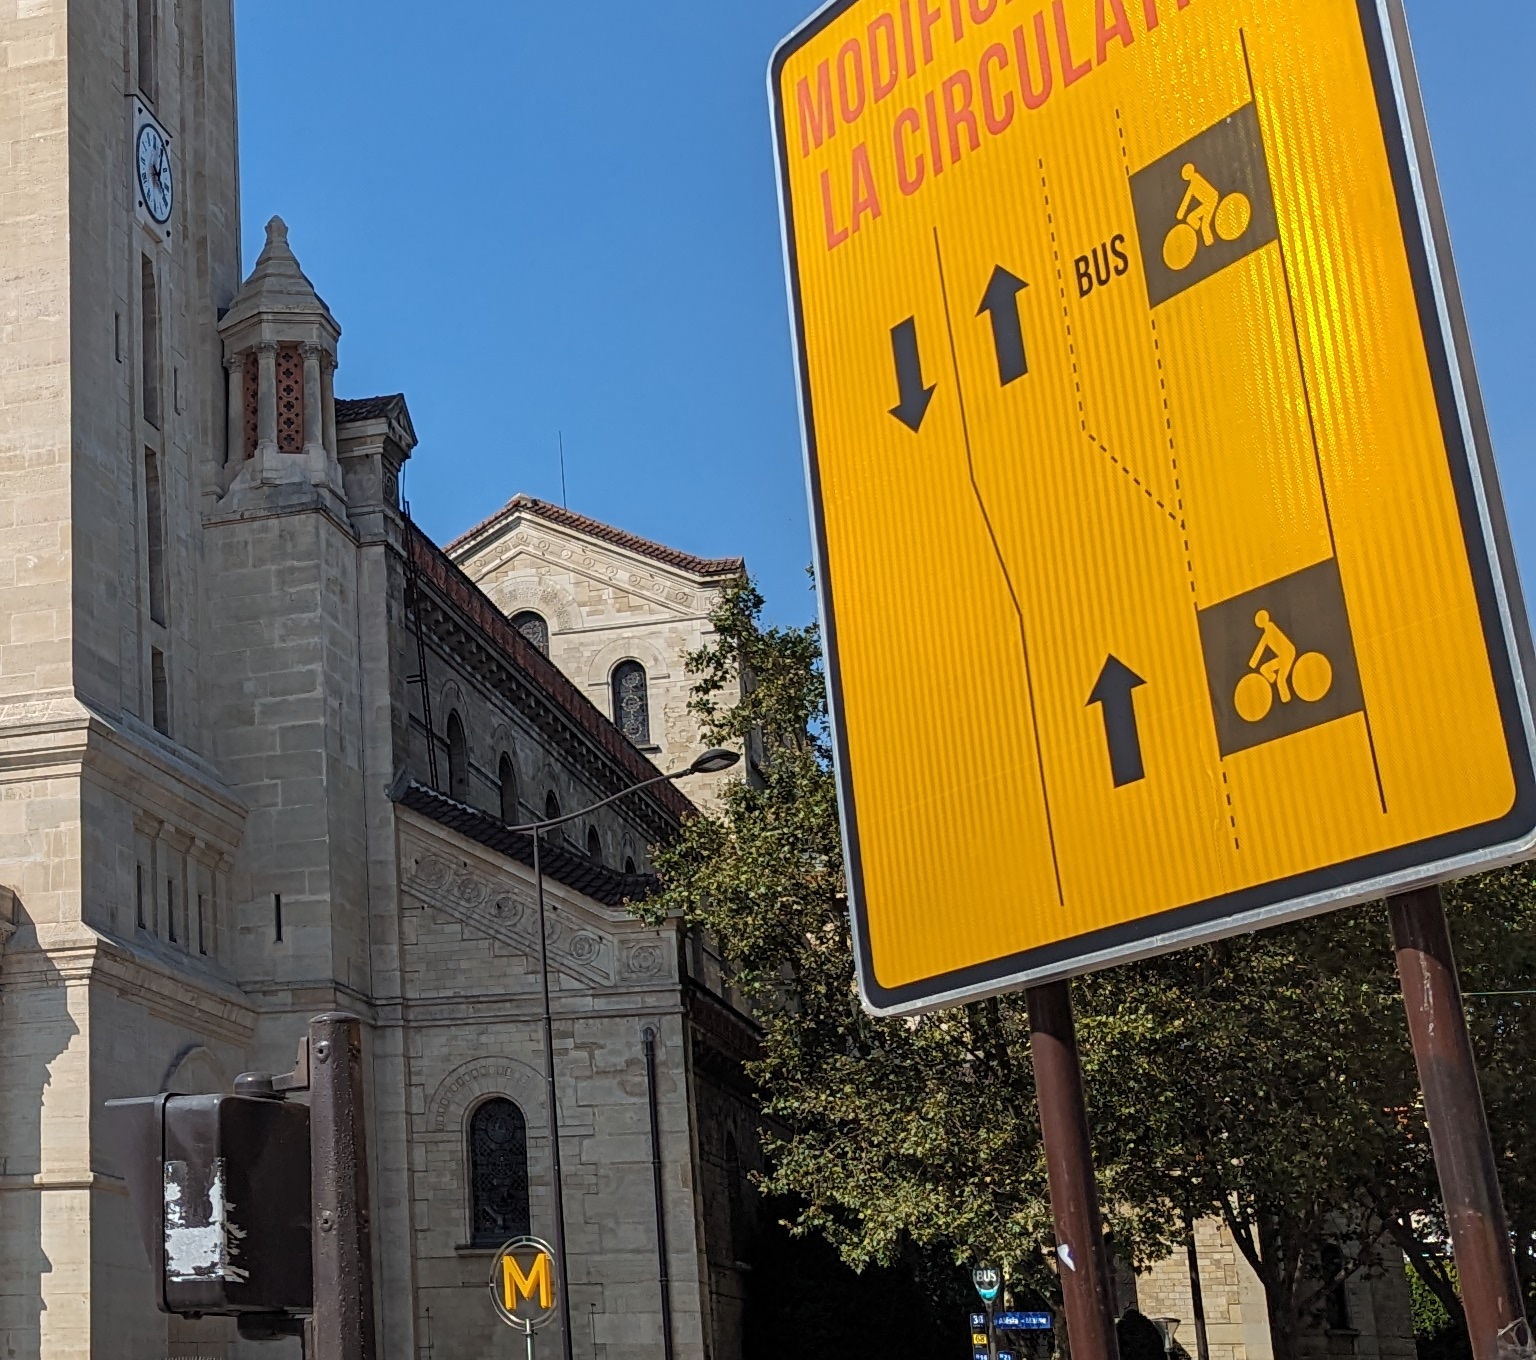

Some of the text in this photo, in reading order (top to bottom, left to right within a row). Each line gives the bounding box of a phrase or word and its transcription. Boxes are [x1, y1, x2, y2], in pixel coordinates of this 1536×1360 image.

[819, 142, 883, 253] LA
[1075, 234, 1129, 300] BUS
[502, 1252, 552, 1309] M
[976, 1269, 996, 1282] BUS
